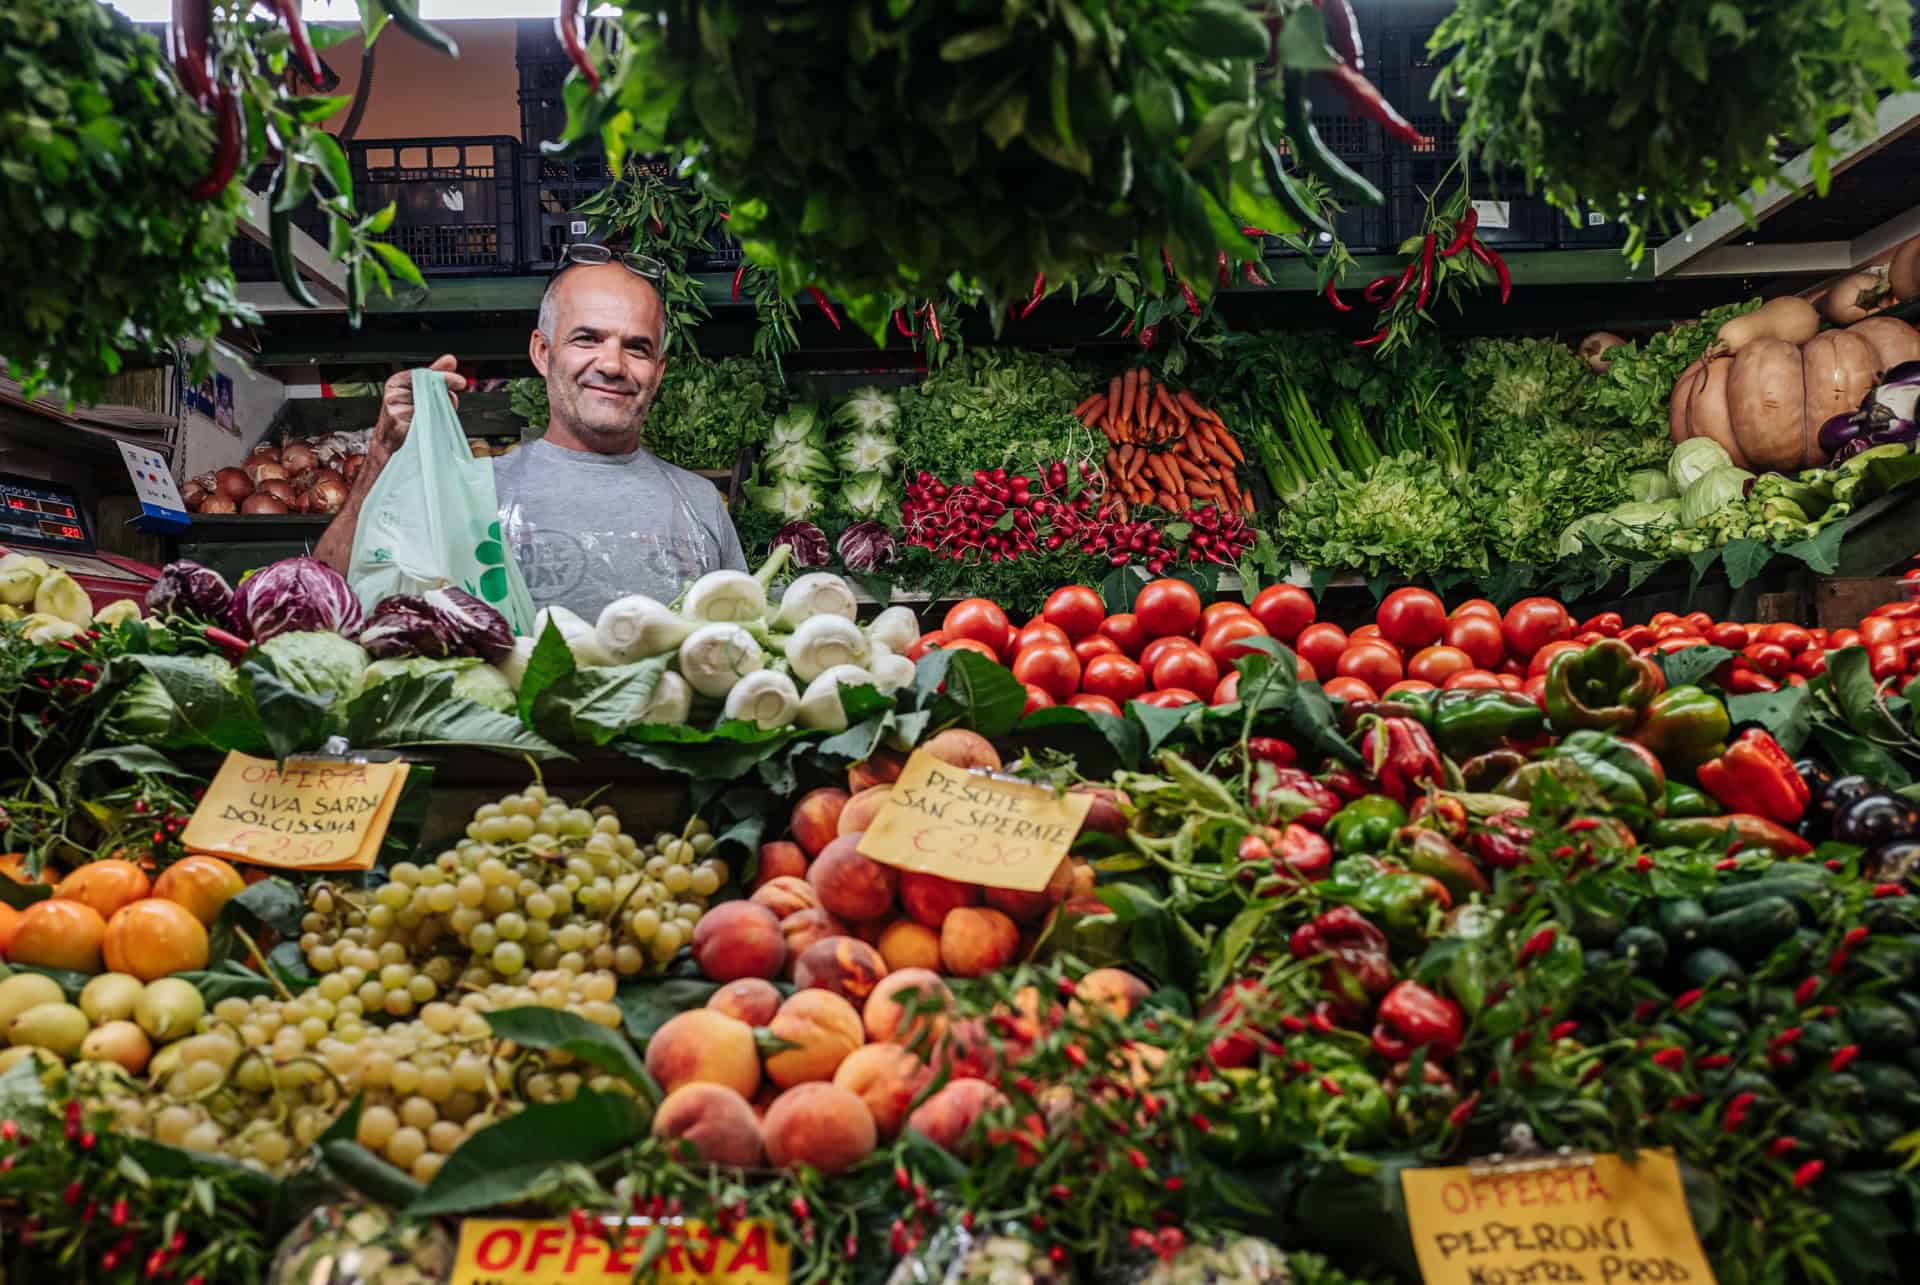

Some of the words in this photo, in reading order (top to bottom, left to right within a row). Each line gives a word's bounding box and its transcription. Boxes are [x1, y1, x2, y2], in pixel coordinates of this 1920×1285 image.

[249, 792, 301, 814] UVA
[895, 788, 952, 819] SAN
[925, 770, 1022, 813] PESCHE
[218, 804, 356, 834] DOLCISSIMA
[1441, 1165, 1612, 1214] OFFERTA
[1434, 1216, 1633, 1261] PEPERONI
